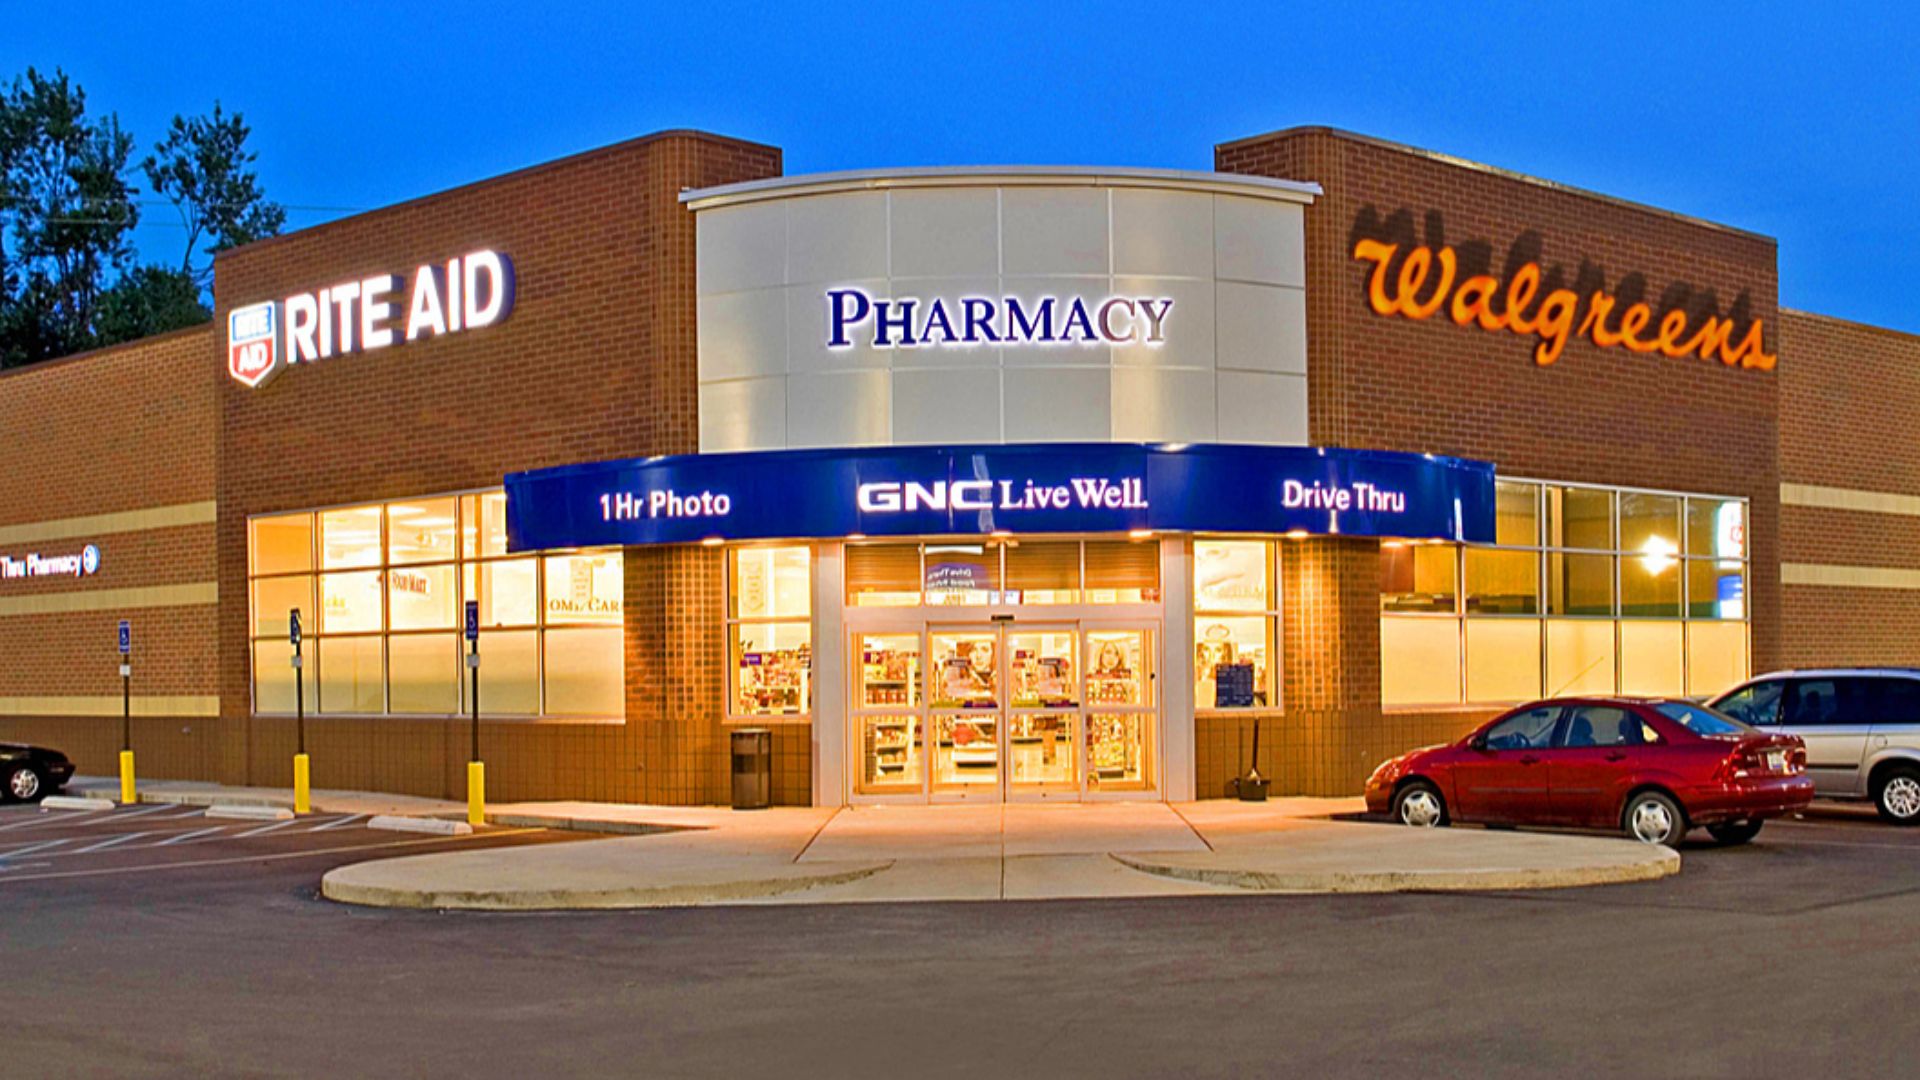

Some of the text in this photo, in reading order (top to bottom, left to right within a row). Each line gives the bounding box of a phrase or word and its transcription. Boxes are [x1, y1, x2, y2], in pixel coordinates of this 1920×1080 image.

[285, 249, 503, 364] RITE AID
[827, 289, 1173, 346] PHARMACY
[1354, 239, 1777, 370] Walgreens
[601, 490, 731, 521] 1 Hr Photo
[858, 480, 993, 512] GNC
[1283, 480, 1405, 512] Drive Thru
[588, 597, 623, 612] CAR
